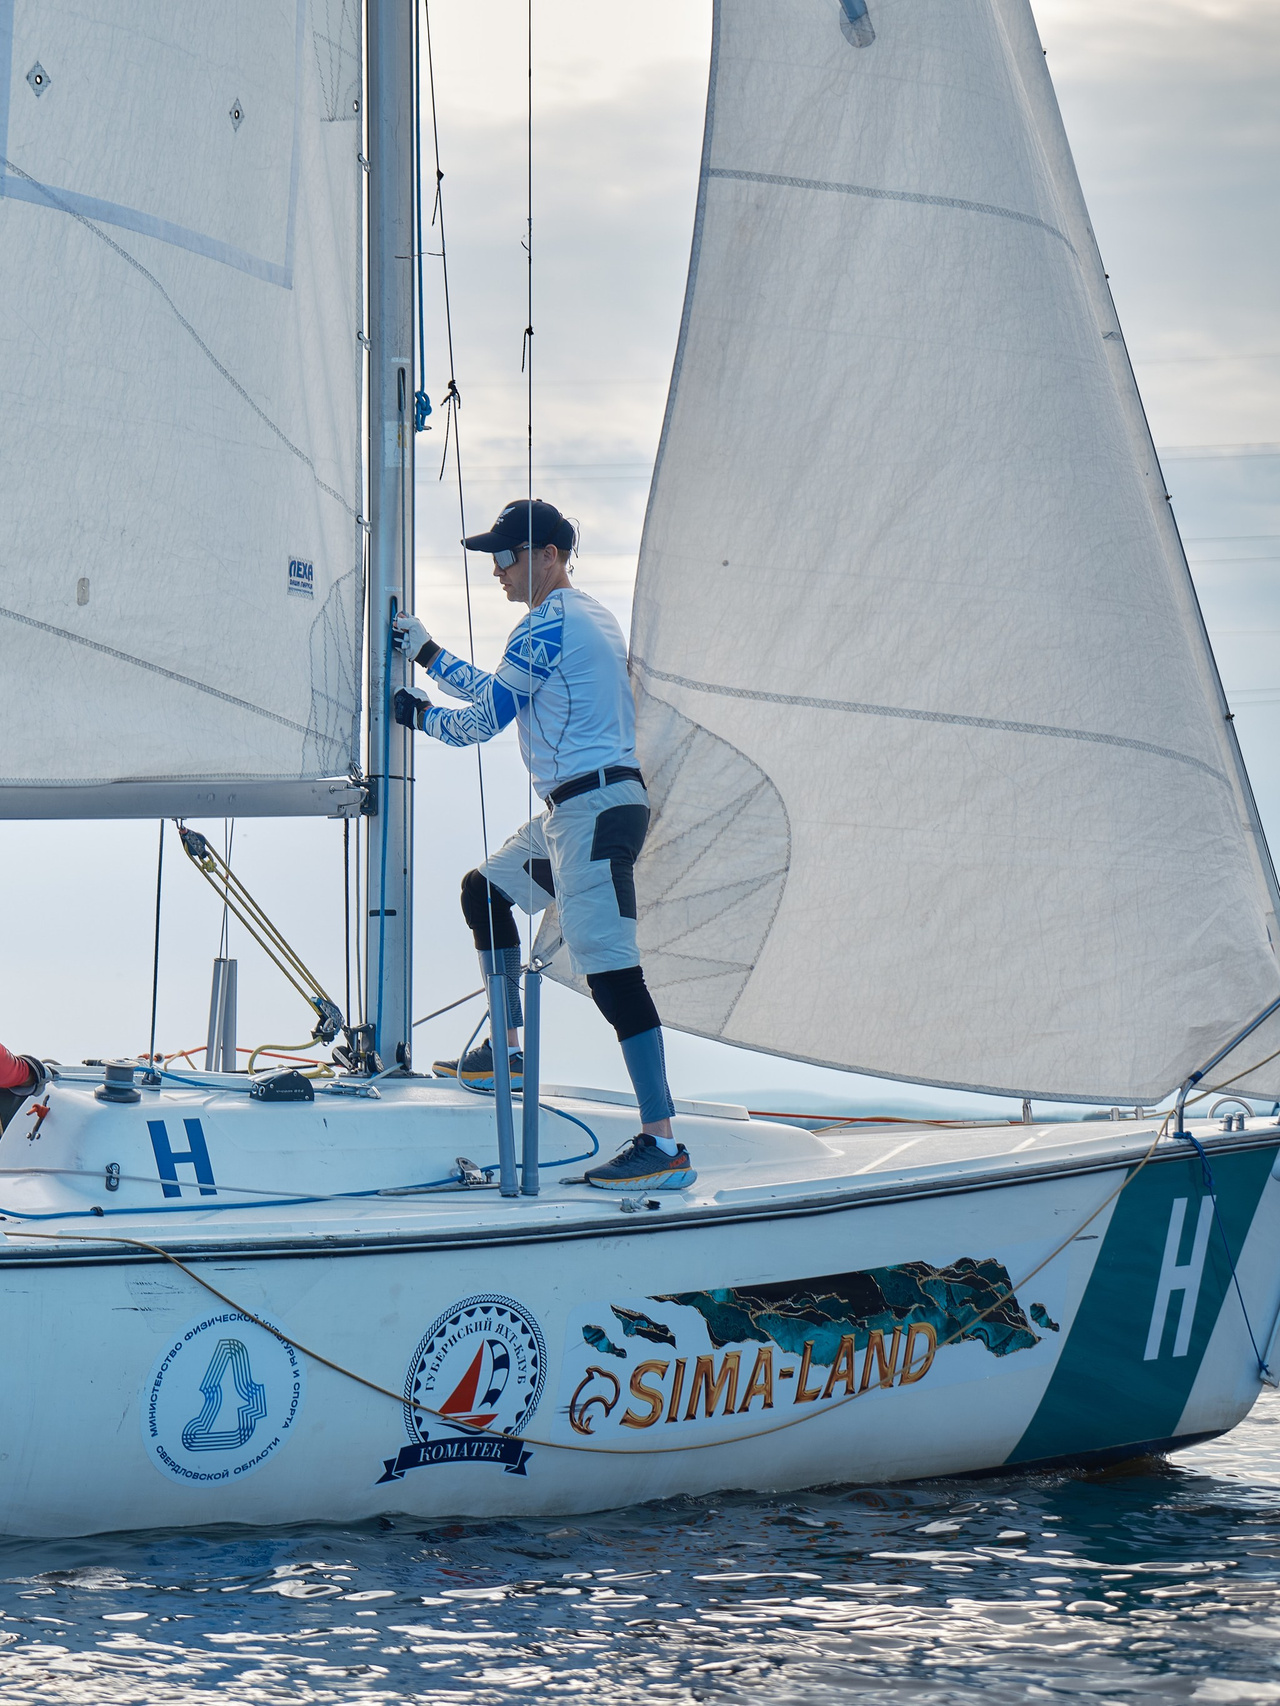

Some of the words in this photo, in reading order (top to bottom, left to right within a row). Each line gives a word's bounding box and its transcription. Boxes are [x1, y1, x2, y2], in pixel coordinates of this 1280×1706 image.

[146, 1118, 217, 1198] H
[1143, 1195, 1217, 1361] H
[184, 1313, 259, 1341] ФИЗИЧЕСКОЙ
[425, 1317, 493, 1391] ГУБЕРНСКИЙ
[494, 1323, 526, 1384] ЯХТ-КЛУБ
[148, 1342, 183, 1437] МИНИСТЕРСТВО
[292, 1369, 300, 1378] И
[619, 1321, 937, 1429] SIMA-LAND
[282, 1382, 301, 1429] СПОРТА
[156, 1445, 229, 1481] СВЕРДЛОВСКОЙ
[233, 1437, 280, 1475] ОБЛАСТИ
[418, 1442, 505, 1462] КОМАТЕК
